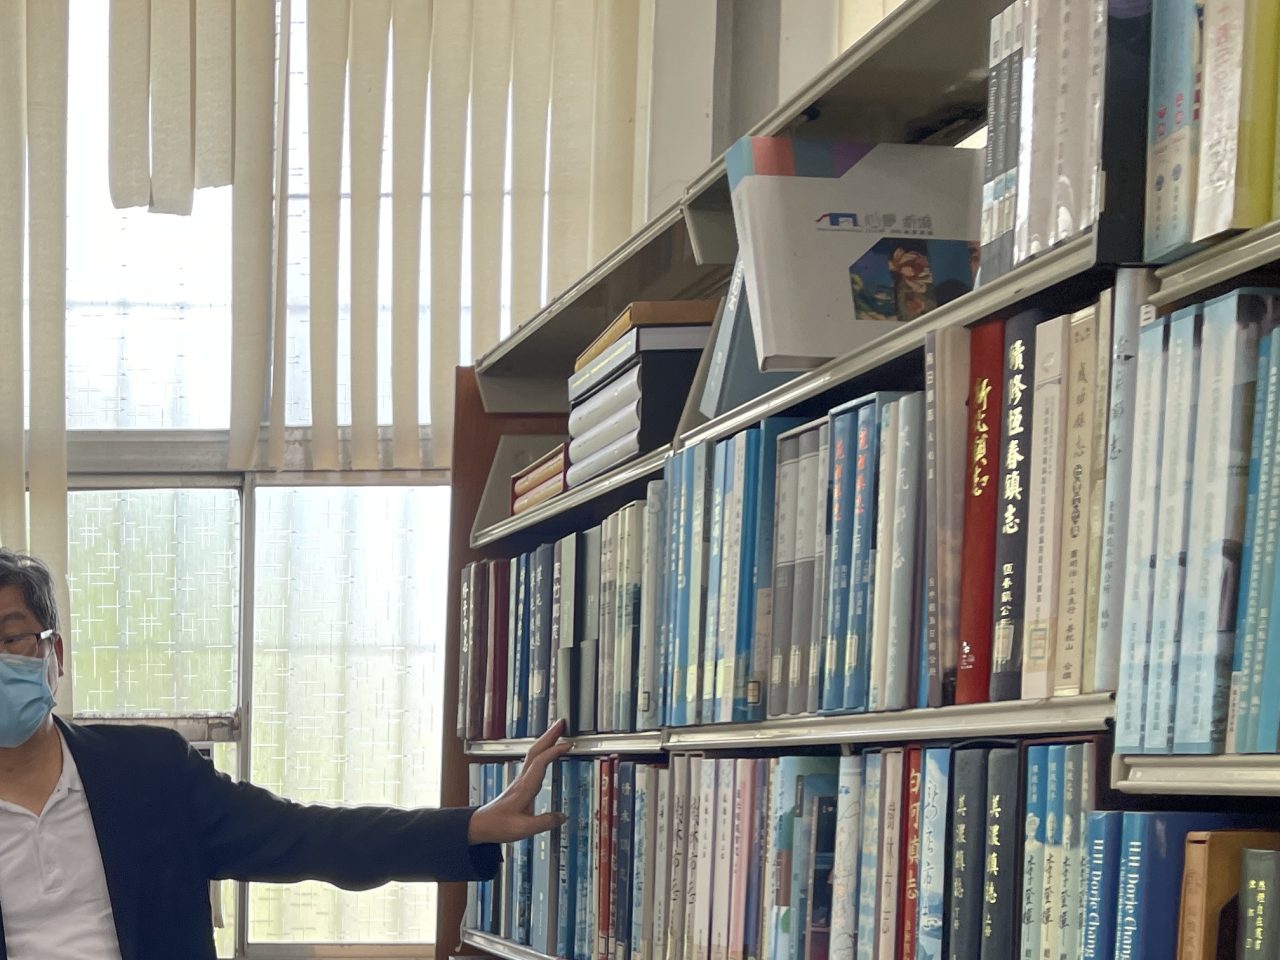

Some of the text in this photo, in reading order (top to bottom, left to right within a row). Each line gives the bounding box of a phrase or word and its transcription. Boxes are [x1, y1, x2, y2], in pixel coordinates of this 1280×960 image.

[1089, 870, 1102, 910] Dorje
[1126, 873, 1140, 914] Dorje
[1084, 912, 1100, 958] Chang
